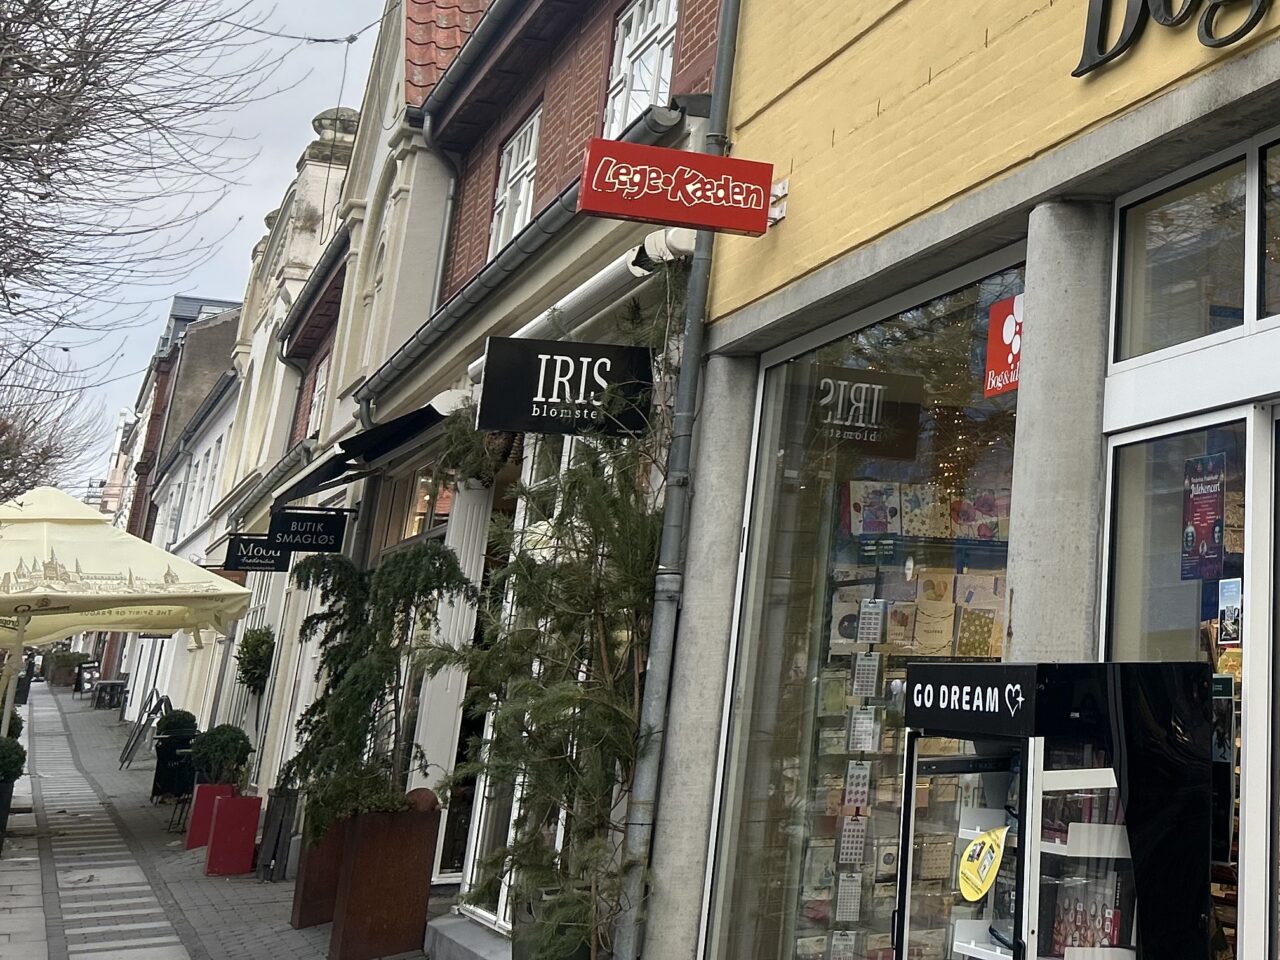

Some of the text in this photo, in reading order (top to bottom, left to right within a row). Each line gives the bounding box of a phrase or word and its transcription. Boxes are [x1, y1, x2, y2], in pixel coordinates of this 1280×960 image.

[532, 354, 612, 406] IRIS
[987, 361, 1020, 390] Bog&id
[531, 404, 600, 419] blomste
[291, 521, 324, 532] BUTIK
[275, 533, 335, 545] SMAGLØS
[914, 683, 999, 713] GO DREAM
